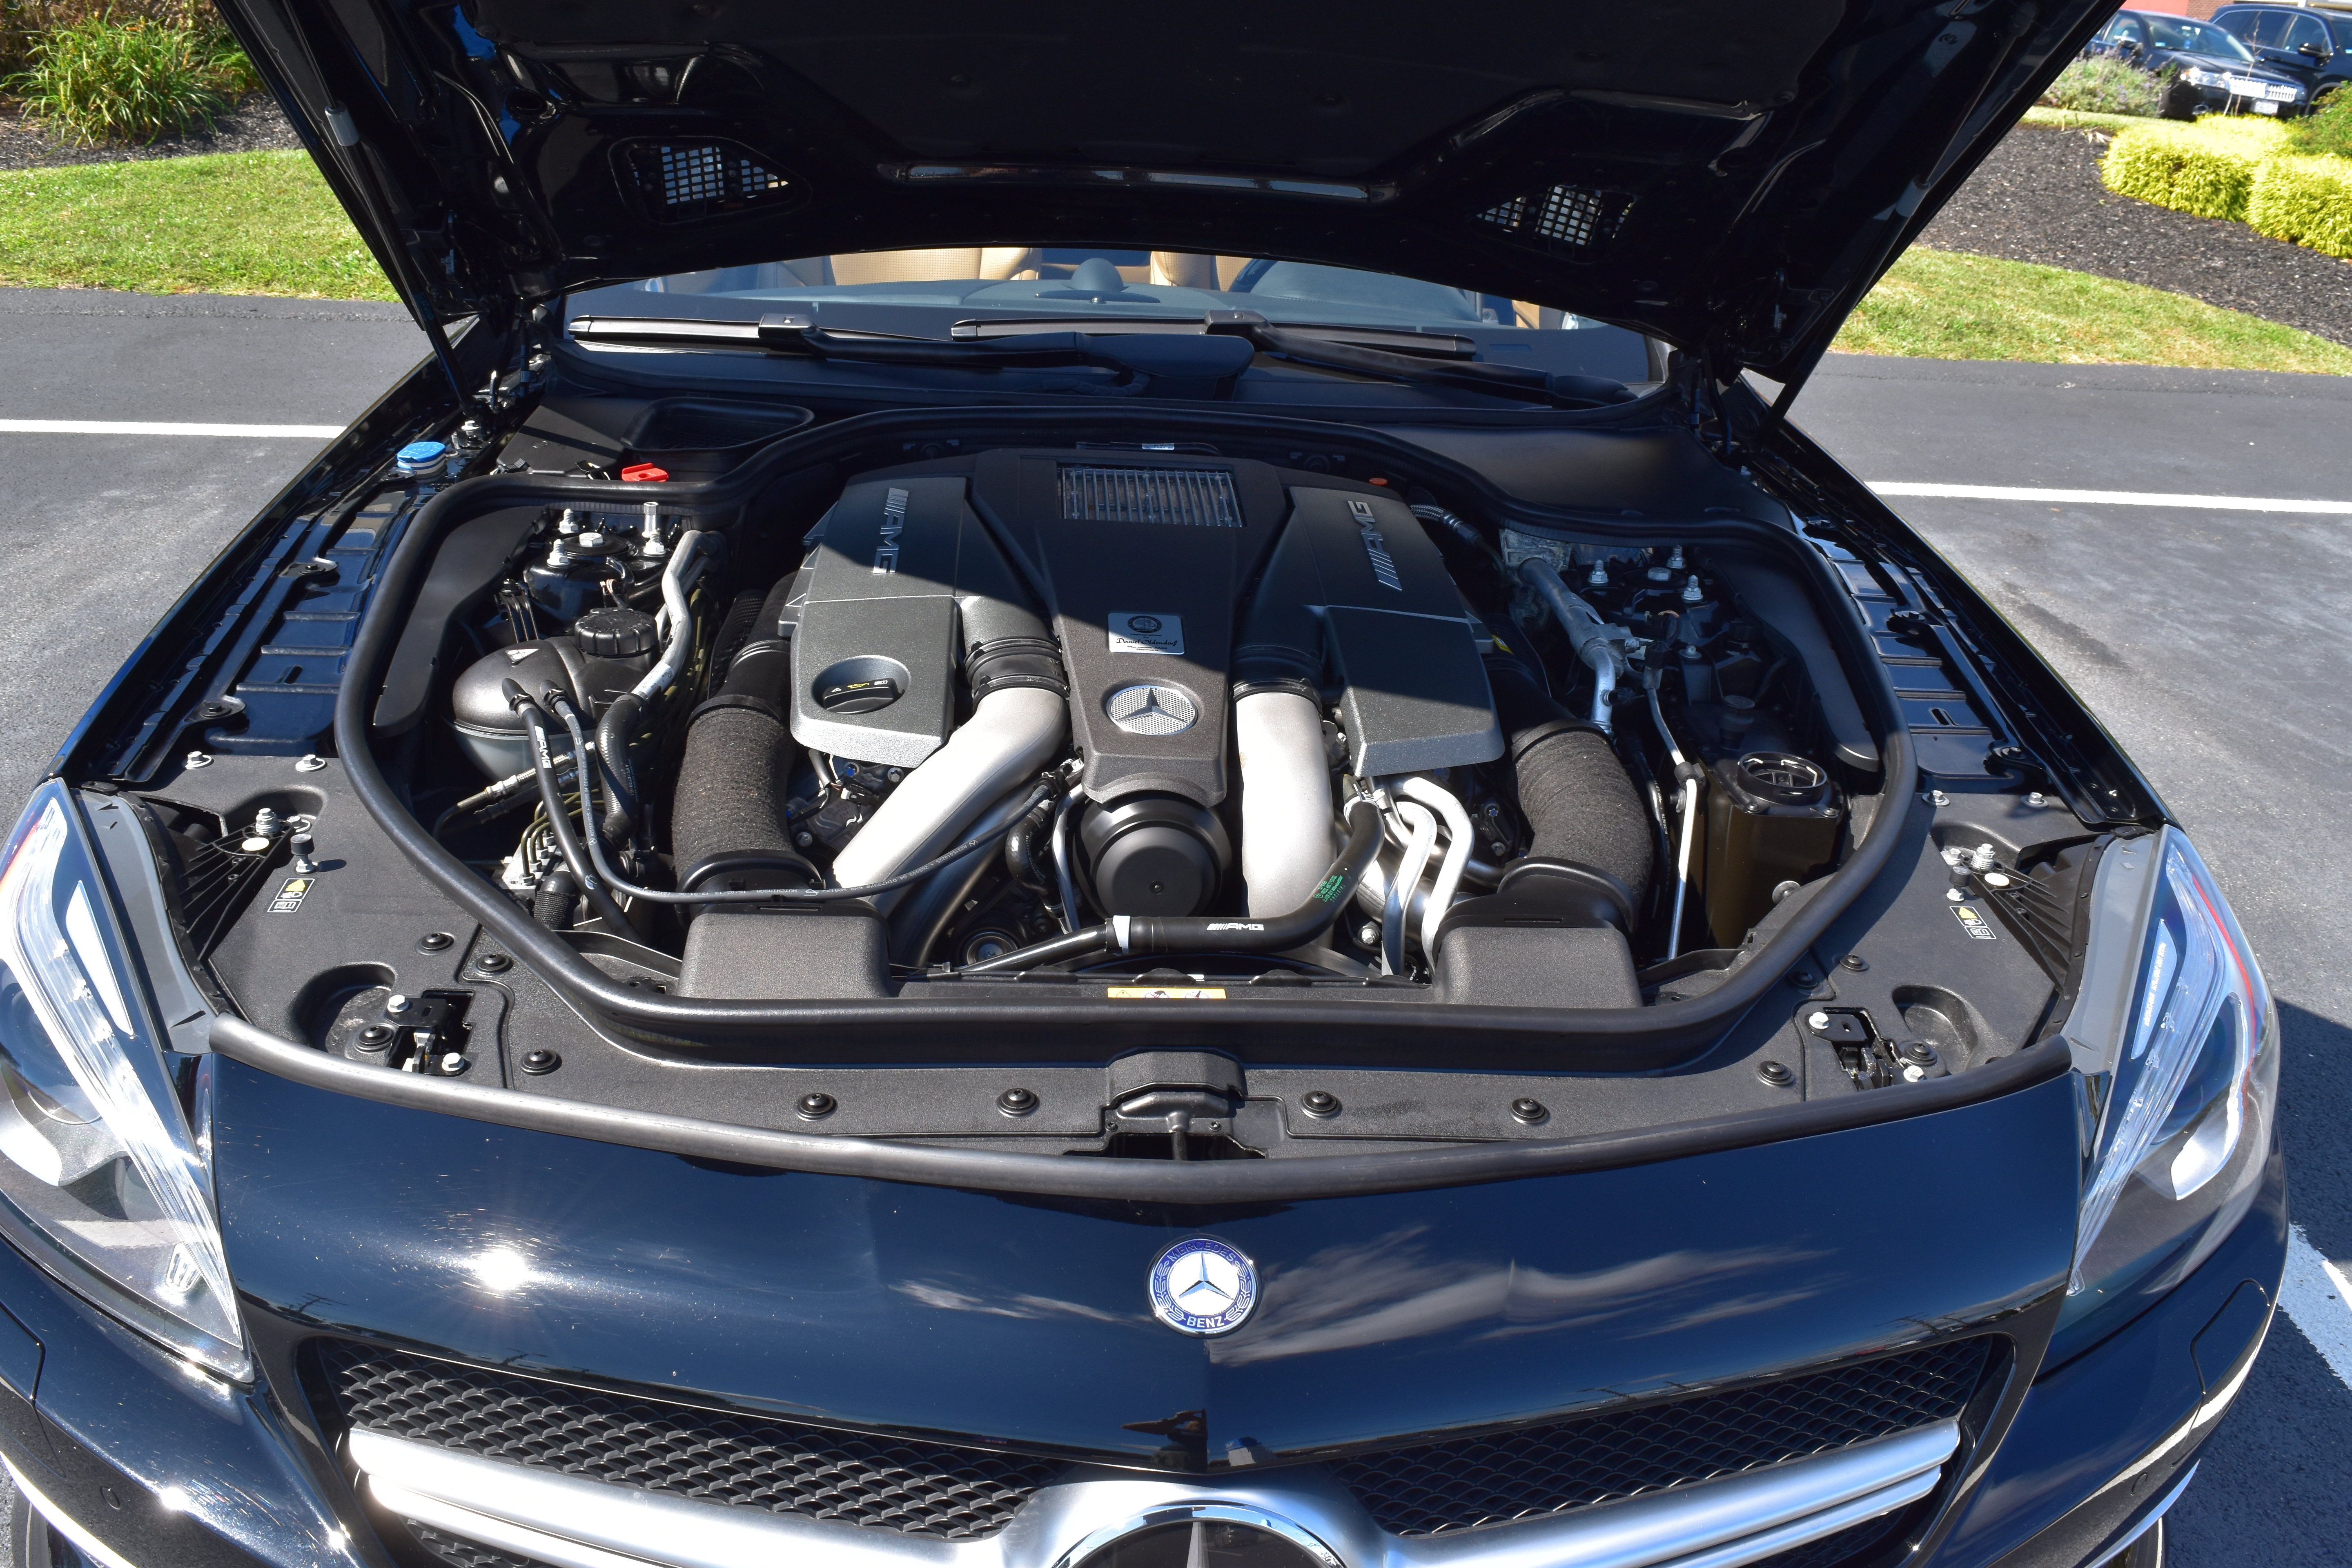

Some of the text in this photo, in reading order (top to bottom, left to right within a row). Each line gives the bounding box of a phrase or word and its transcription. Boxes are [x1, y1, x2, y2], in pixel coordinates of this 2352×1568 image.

[537, 739, 552, 768] AMG
[1167, 1241, 1236, 1262] MERCEDES
[1187, 1316, 1225, 1328] BENZ
